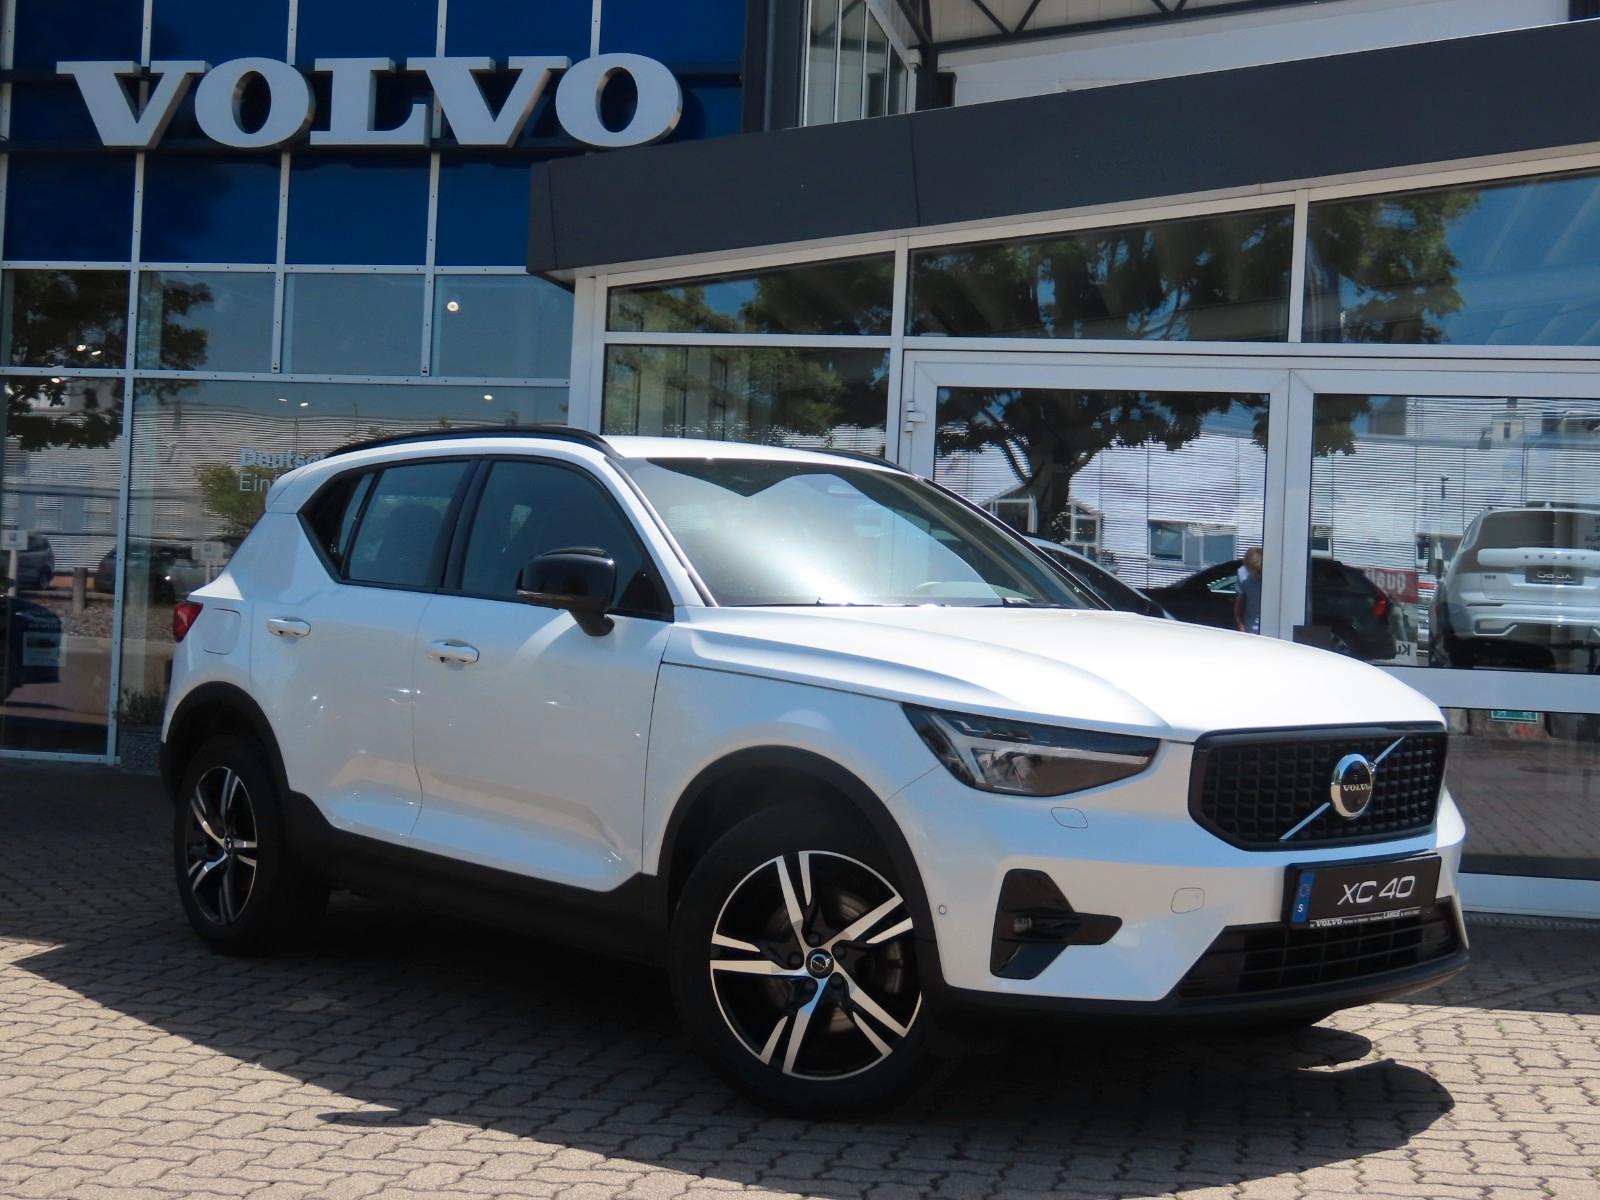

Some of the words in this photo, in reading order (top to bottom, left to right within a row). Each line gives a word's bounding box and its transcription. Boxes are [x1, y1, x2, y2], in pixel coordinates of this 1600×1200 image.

[56, 52, 683, 149] VOLVO
[1342, 783, 1371, 792] VOLVO
[1297, 903, 1304, 913] S
[1315, 918, 1343, 928] VOLVO
